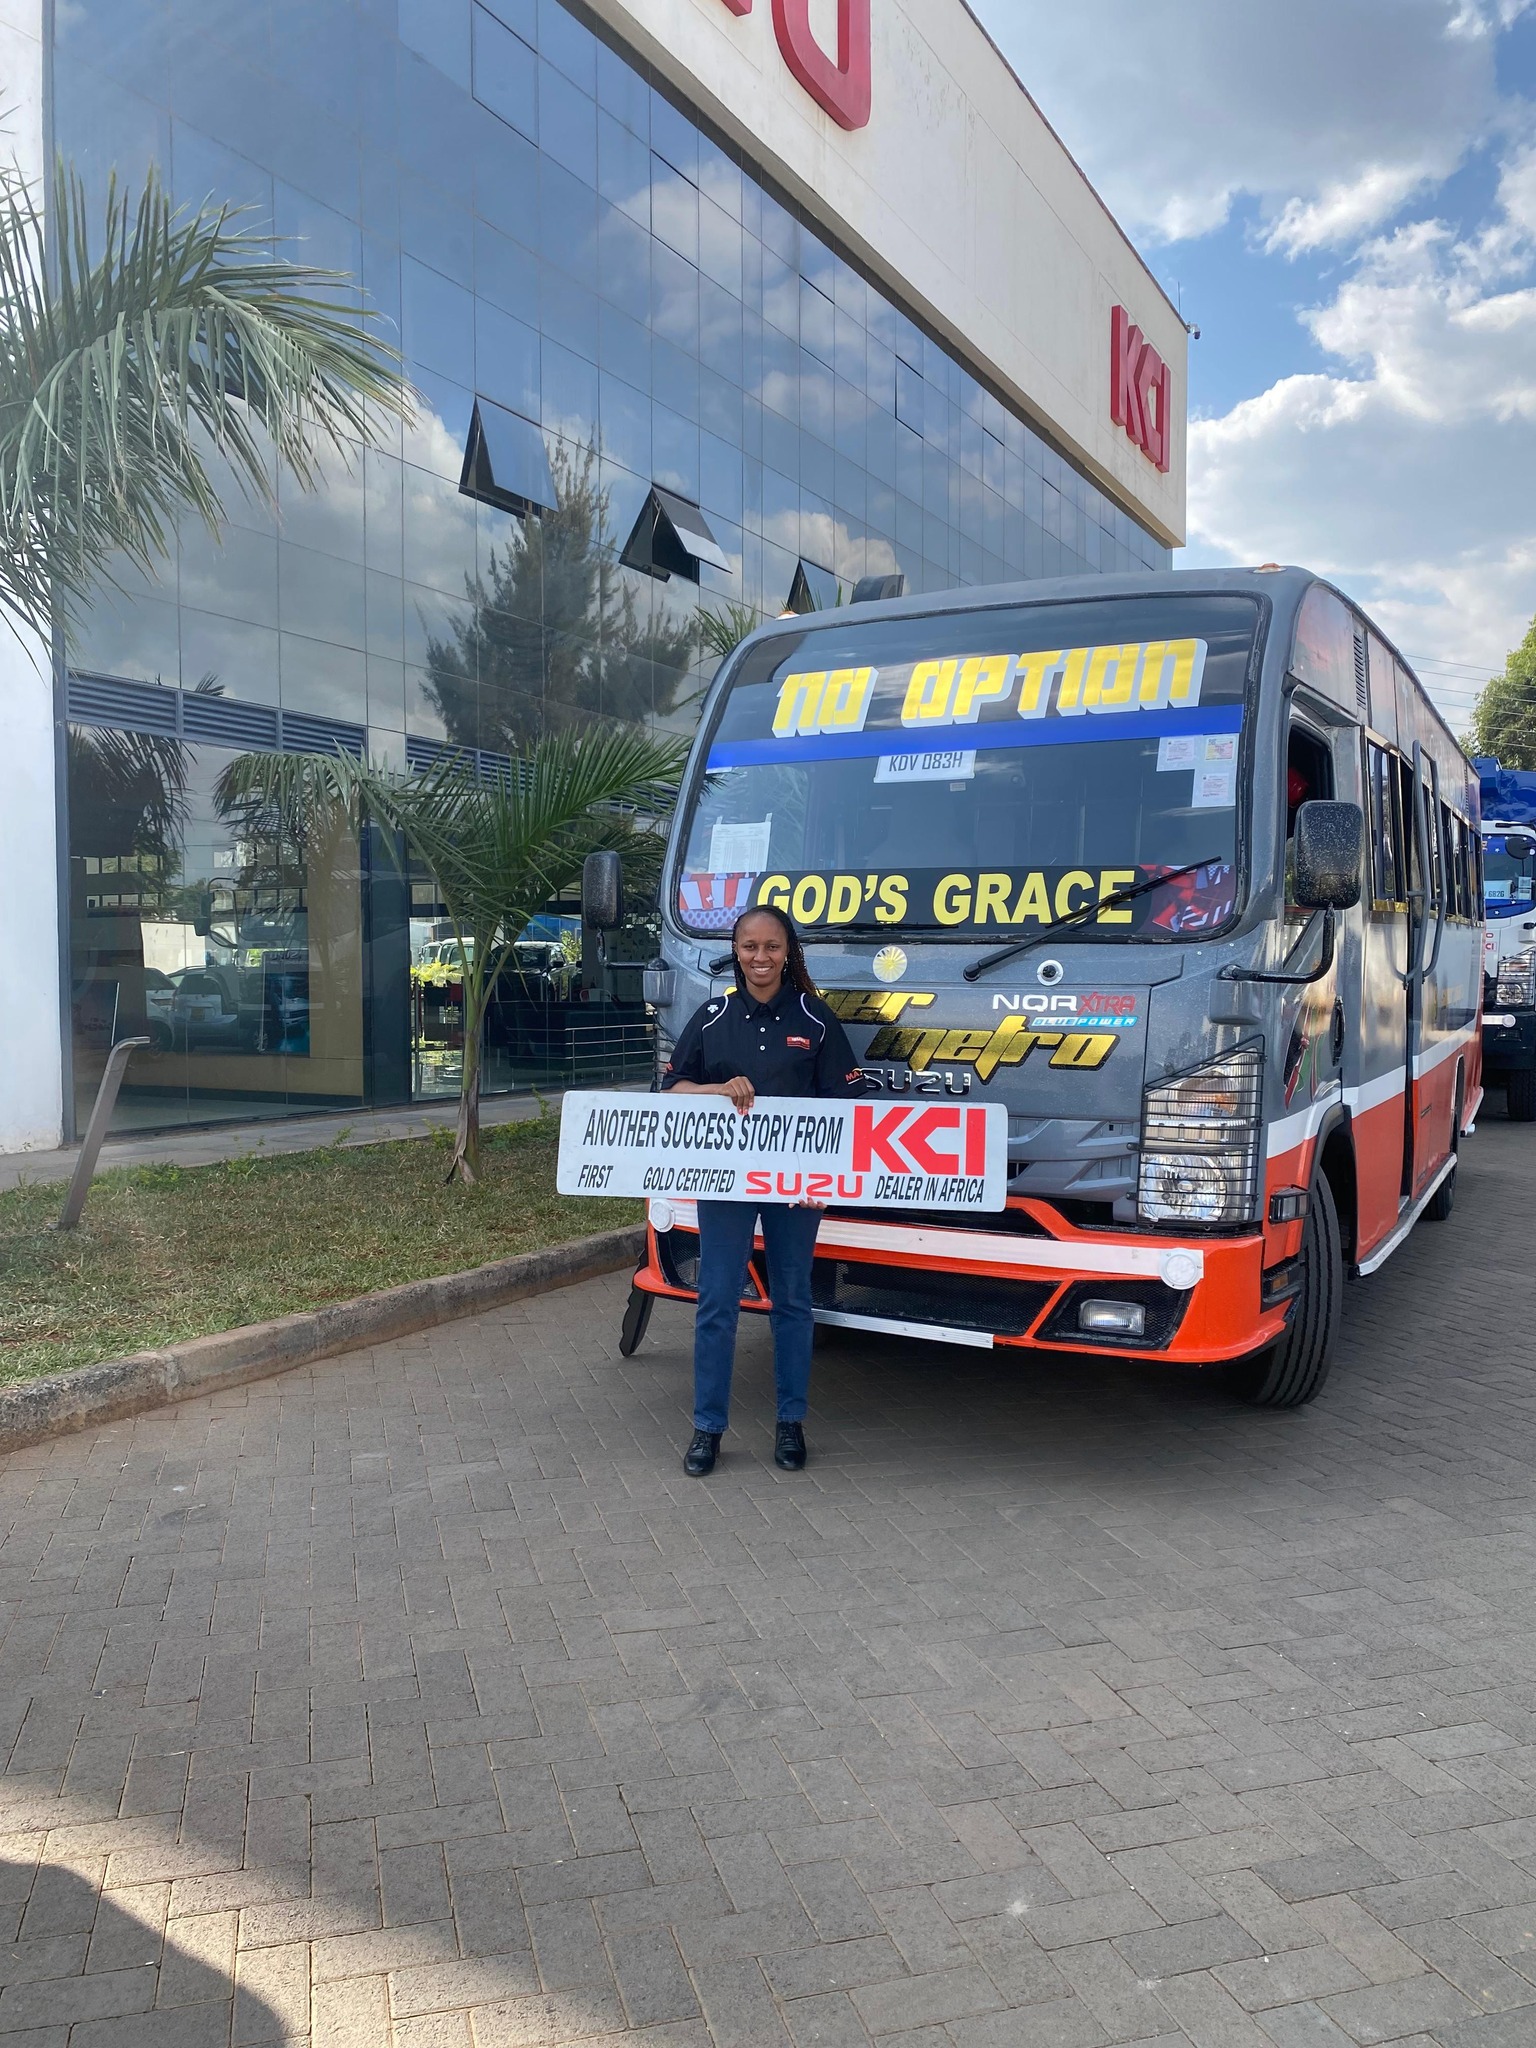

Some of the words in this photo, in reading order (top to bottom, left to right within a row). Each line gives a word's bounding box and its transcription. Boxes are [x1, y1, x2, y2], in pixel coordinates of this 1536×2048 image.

[1111, 305, 1170, 473] KCI
[888, 754, 919, 772] KDV
[922, 752, 963, 770] 083H
[757, 874, 909, 925] GOD'S
[933, 870, 1136, 925] GRACE
[860, 1067, 971, 1096] SUZU
[583, 1109, 659, 1148] ANOTHER
[661, 1111, 737, 1150] SUCCESS
[738, 1113, 793, 1153] STORY
[792, 1115, 844, 1154] FROM
[852, 1105, 986, 1176] KCI
[577, 1165, 614, 1189] FIRST
[643, 1166, 675, 1191] GOLD
[676, 1168, 736, 1193] CERTIFIED
[874, 1175, 924, 1201] DEALER
[924, 1177, 940, 1202] IN
[939, 1178, 986, 1203] AFRICA
